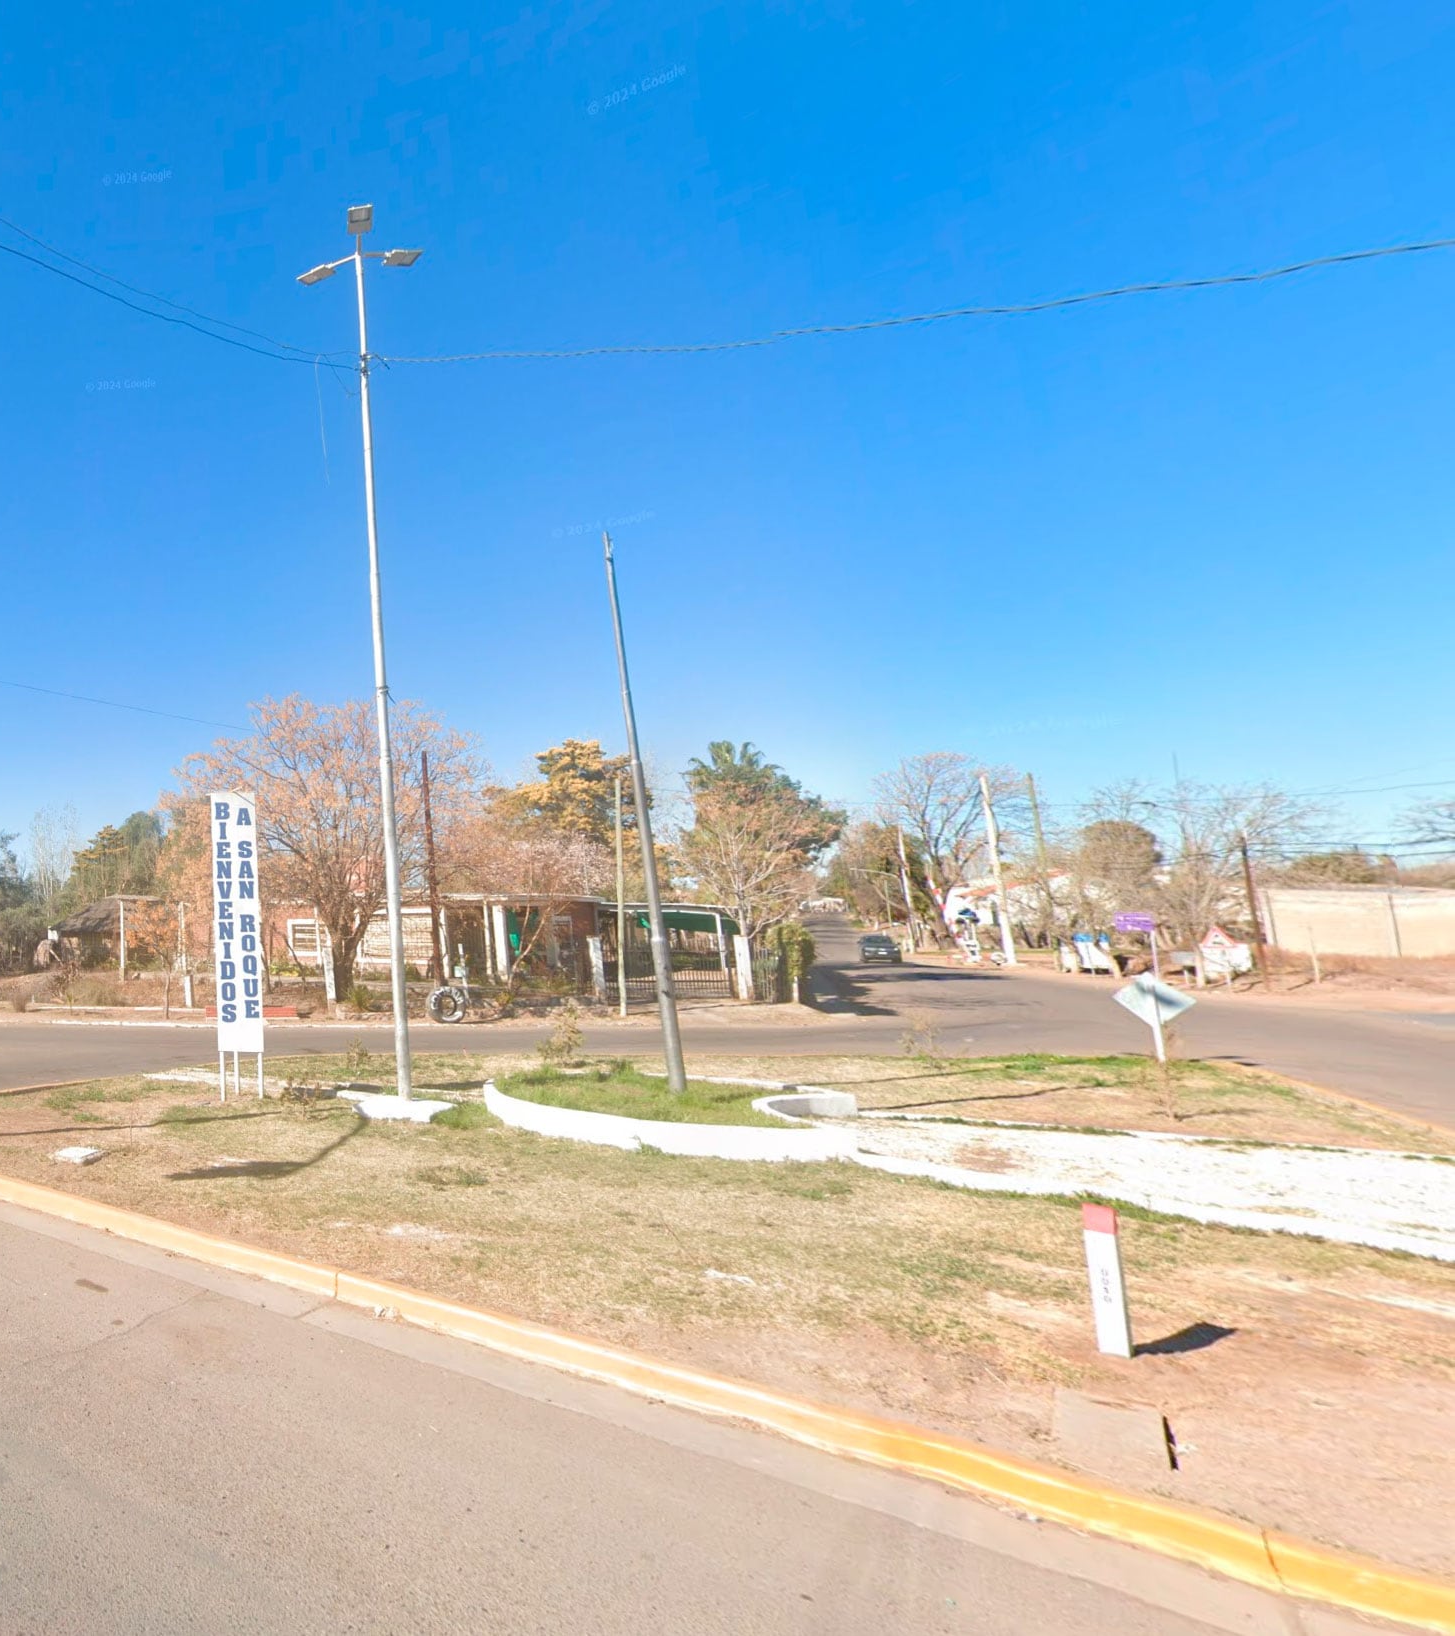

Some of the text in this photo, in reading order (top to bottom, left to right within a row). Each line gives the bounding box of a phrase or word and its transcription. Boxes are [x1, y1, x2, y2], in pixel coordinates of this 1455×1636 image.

[214, 801, 237, 1023] BIENVENIDOS
[236, 807, 260, 1019] A SAN ROQUE
